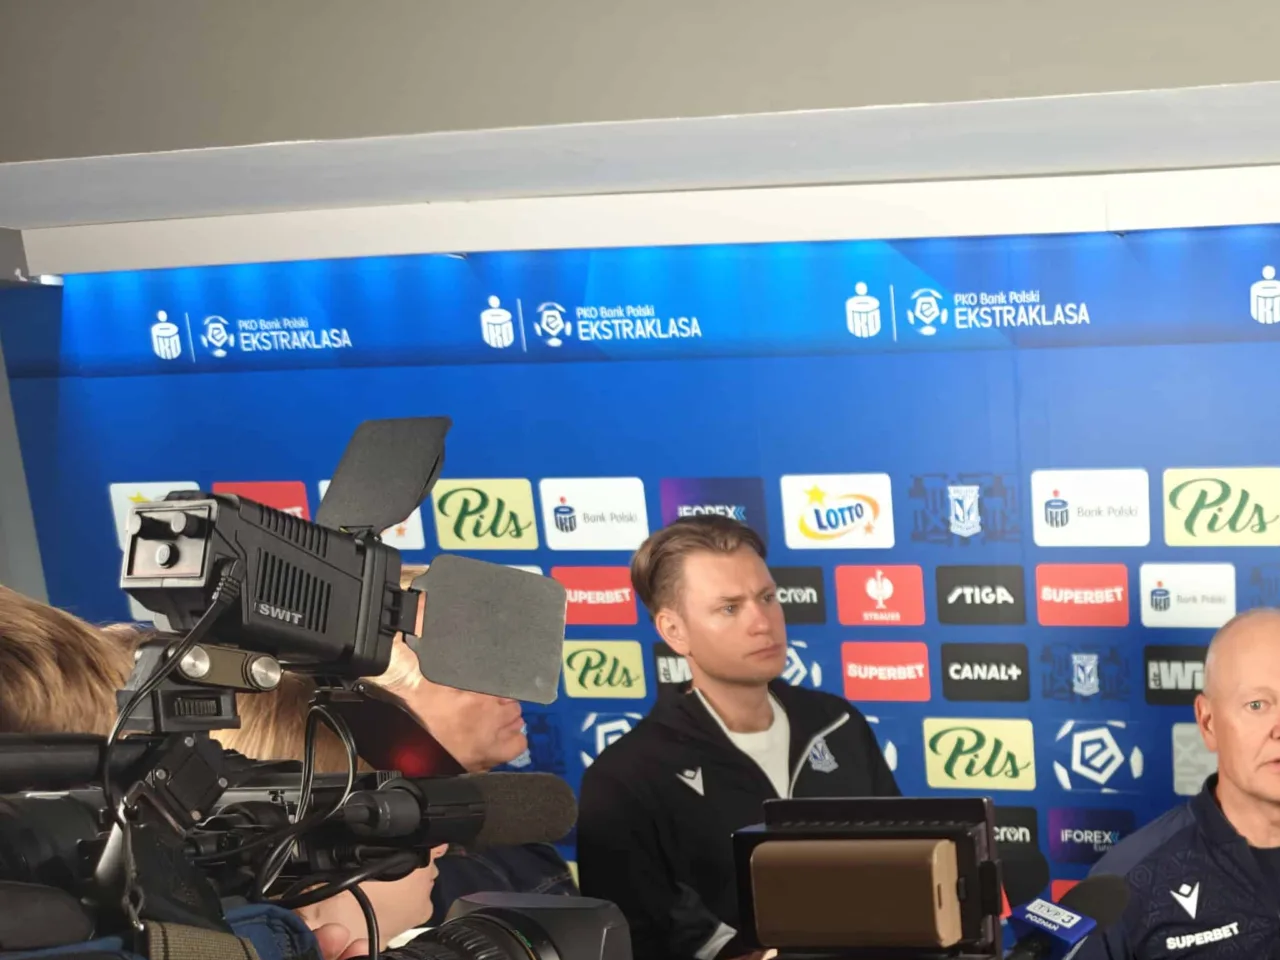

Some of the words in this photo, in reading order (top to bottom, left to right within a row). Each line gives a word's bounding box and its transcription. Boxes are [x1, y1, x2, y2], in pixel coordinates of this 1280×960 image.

[954, 293, 977, 306] PKO
[980, 292, 1006, 305] Bank
[1009, 290, 1040, 303] Polski
[576, 307, 597, 319] PKO
[600, 306, 624, 318] Bank
[626, 305, 655, 317] Polski
[955, 303, 1090, 328] EKSTRAKLASA
[577, 317, 702, 340] EKSTRAKLASA
[240, 329, 352, 351] EKSTRAKLASA
[438, 487, 531, 542] Pils
[583, 511, 606, 523] Bank
[610, 511, 638, 523] Polski
[814, 503, 864, 531] LOTTO
[1077, 506, 1104, 518] Bank
[1107, 505, 1139, 518] Polski
[1169, 478, 1280, 537] Pils
[566, 589, 632, 604] UPERBET
[776, 587, 817, 604] cron
[948, 586, 1014, 604] STIGA
[1042, 586, 1124, 604] SUPERBET
[259, 603, 303, 623] SWIT
[567, 648, 638, 688] Pils
[847, 662, 924, 681] SUPERBET
[949, 662, 1022, 681] CANAL+
[929, 726, 1031, 780] Pils
[994, 826, 1030, 842] cron
[1061, 829, 1111, 844] iFOREX
[1166, 922, 1239, 949] SUPERBET
